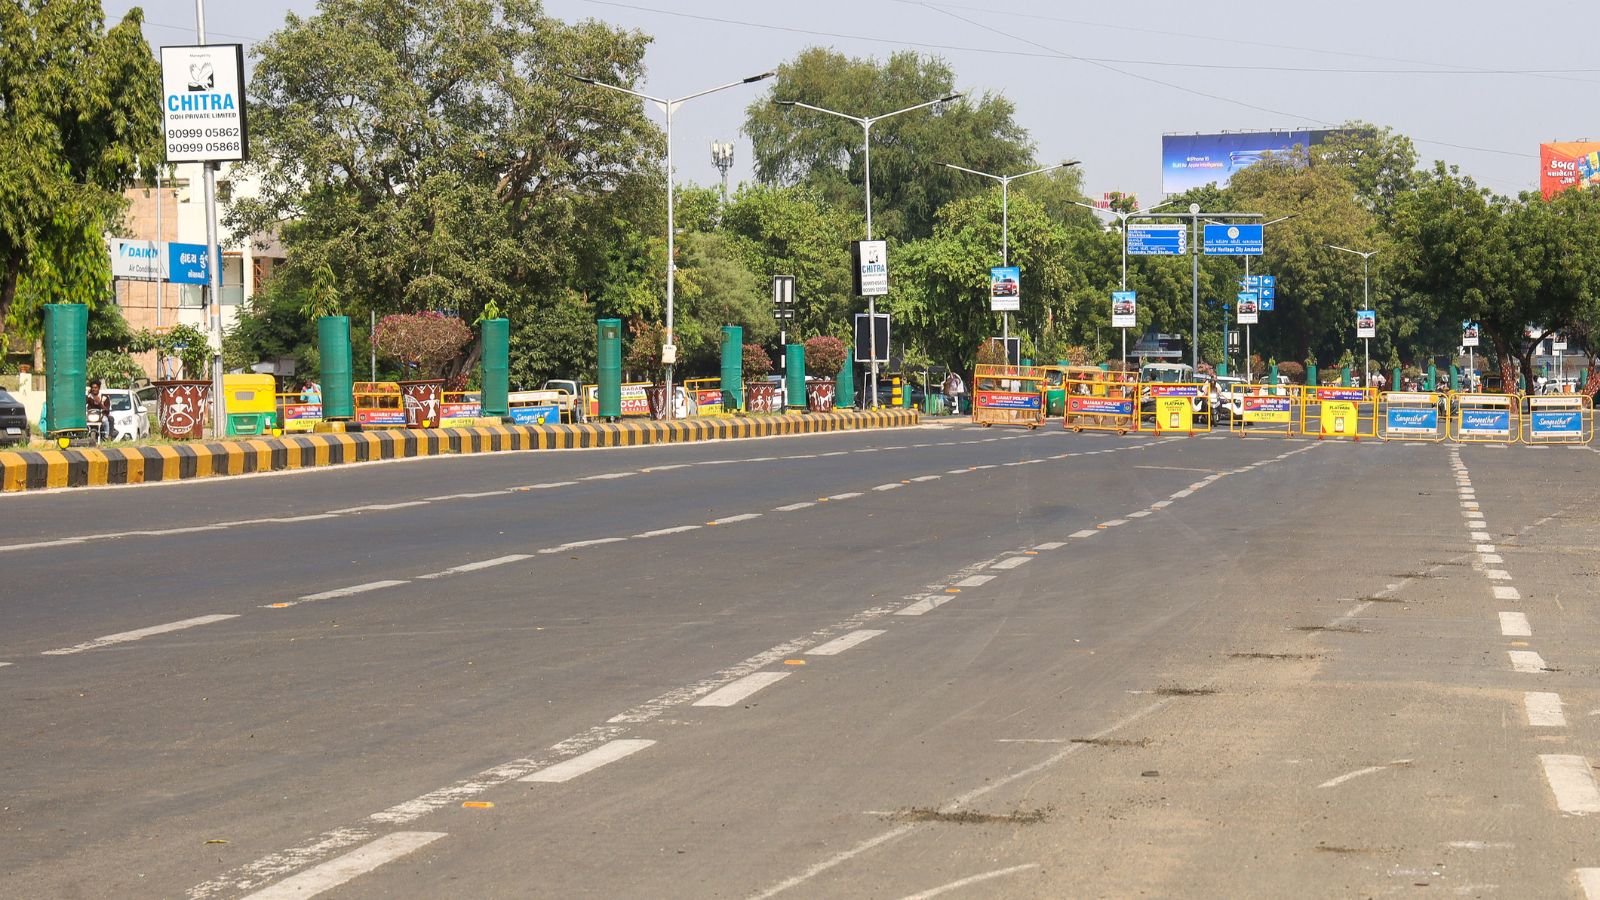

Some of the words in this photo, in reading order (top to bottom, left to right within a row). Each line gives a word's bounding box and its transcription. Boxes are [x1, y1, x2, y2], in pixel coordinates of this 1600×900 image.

[168, 94, 234, 111] CHITRA
[168, 128, 202, 138] 90999
[205, 127, 240, 138] 05862
[168, 143, 203, 153] 90999
[205, 142, 240, 152] 05868
[862, 264, 885, 273] CHITRA
[1394, 413, 1422, 425] Sangeetha
[1466, 415, 1494, 427] Sangeetha
[1538, 417, 1566, 428] Sangeetha
